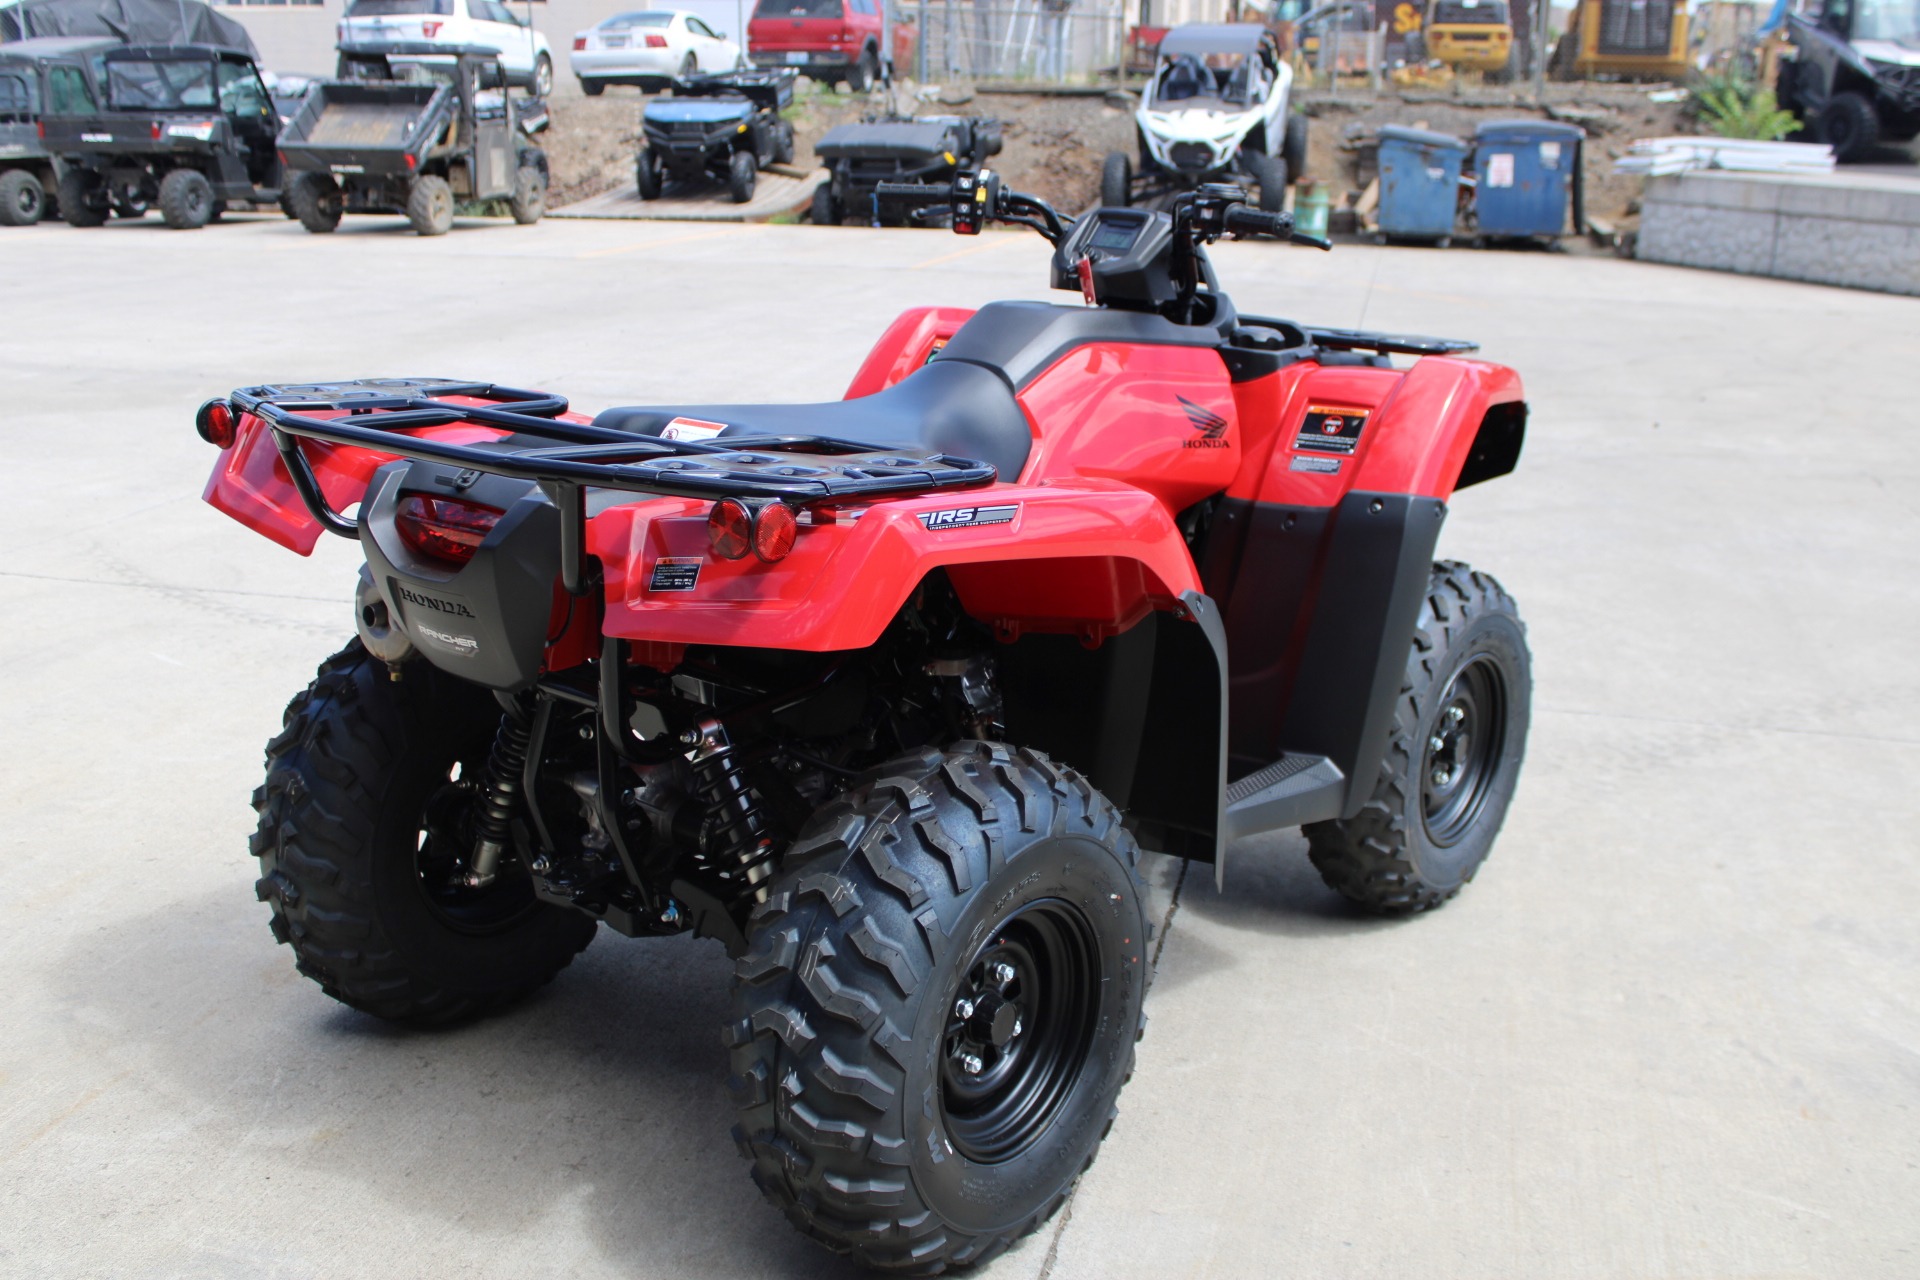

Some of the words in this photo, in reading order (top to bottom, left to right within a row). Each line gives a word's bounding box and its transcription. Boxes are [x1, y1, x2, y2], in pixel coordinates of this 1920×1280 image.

[1182, 439, 1231, 449] HONDA
[929, 508, 974, 525] IRS
[399, 587, 476, 618] HONDA
[417, 625, 479, 648] RANCHER
